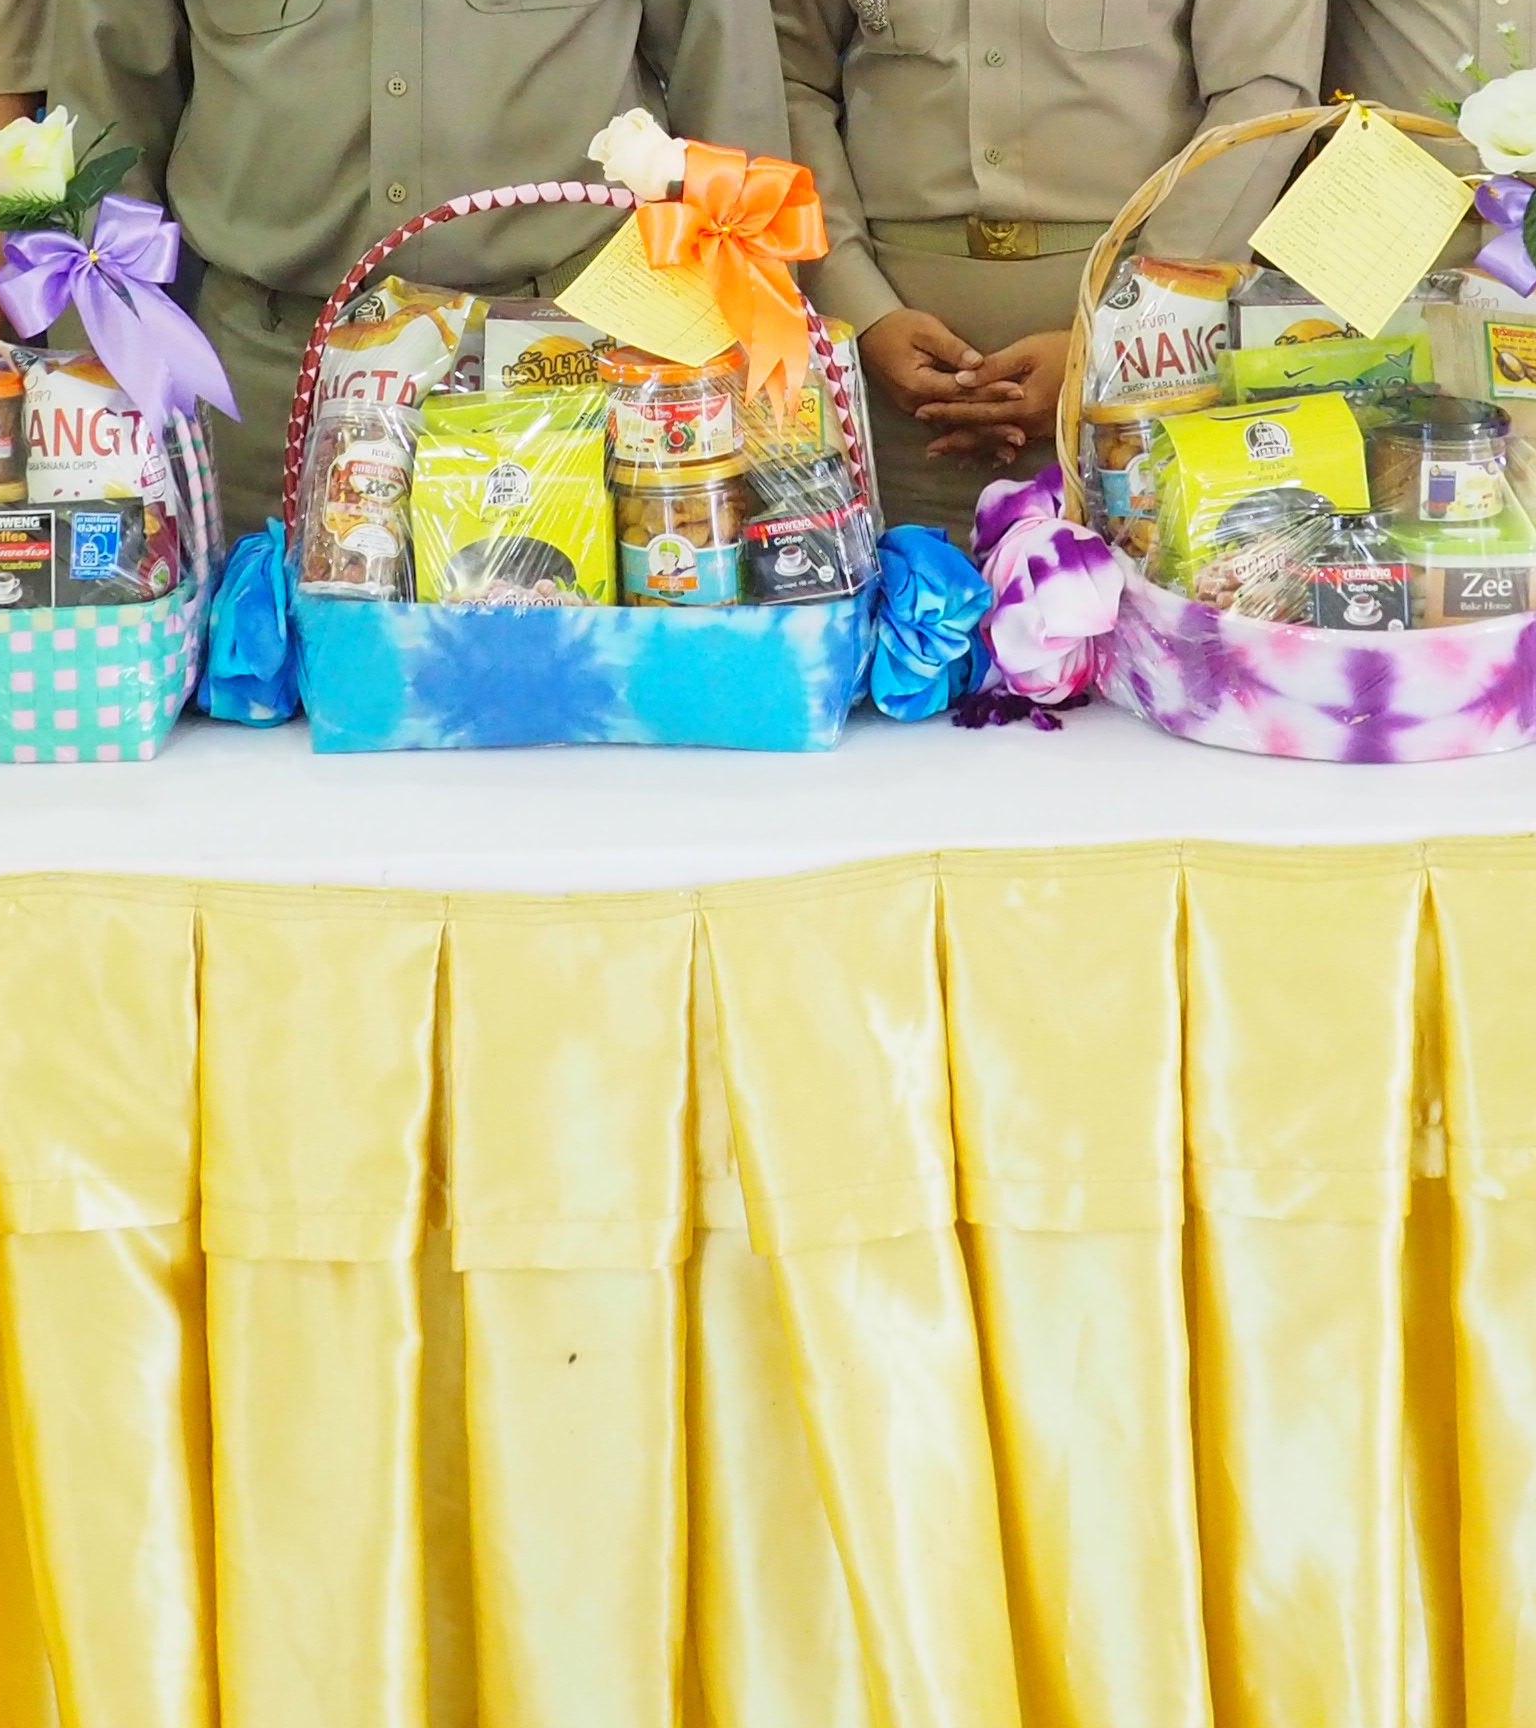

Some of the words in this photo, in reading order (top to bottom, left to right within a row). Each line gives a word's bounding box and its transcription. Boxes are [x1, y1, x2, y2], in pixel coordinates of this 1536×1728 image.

[1121, 383, 1150, 394] CRISPY
[72, 460, 98, 471] CHIPS
[773, 535, 804, 547] Coffee
[1341, 567, 1392, 580] YERWENG
[1348, 582, 1379, 593] Coffee
[1460, 571, 1513, 599] Zee
[1460, 601, 1481, 612] Bake
[1483, 601, 1513, 612] House
